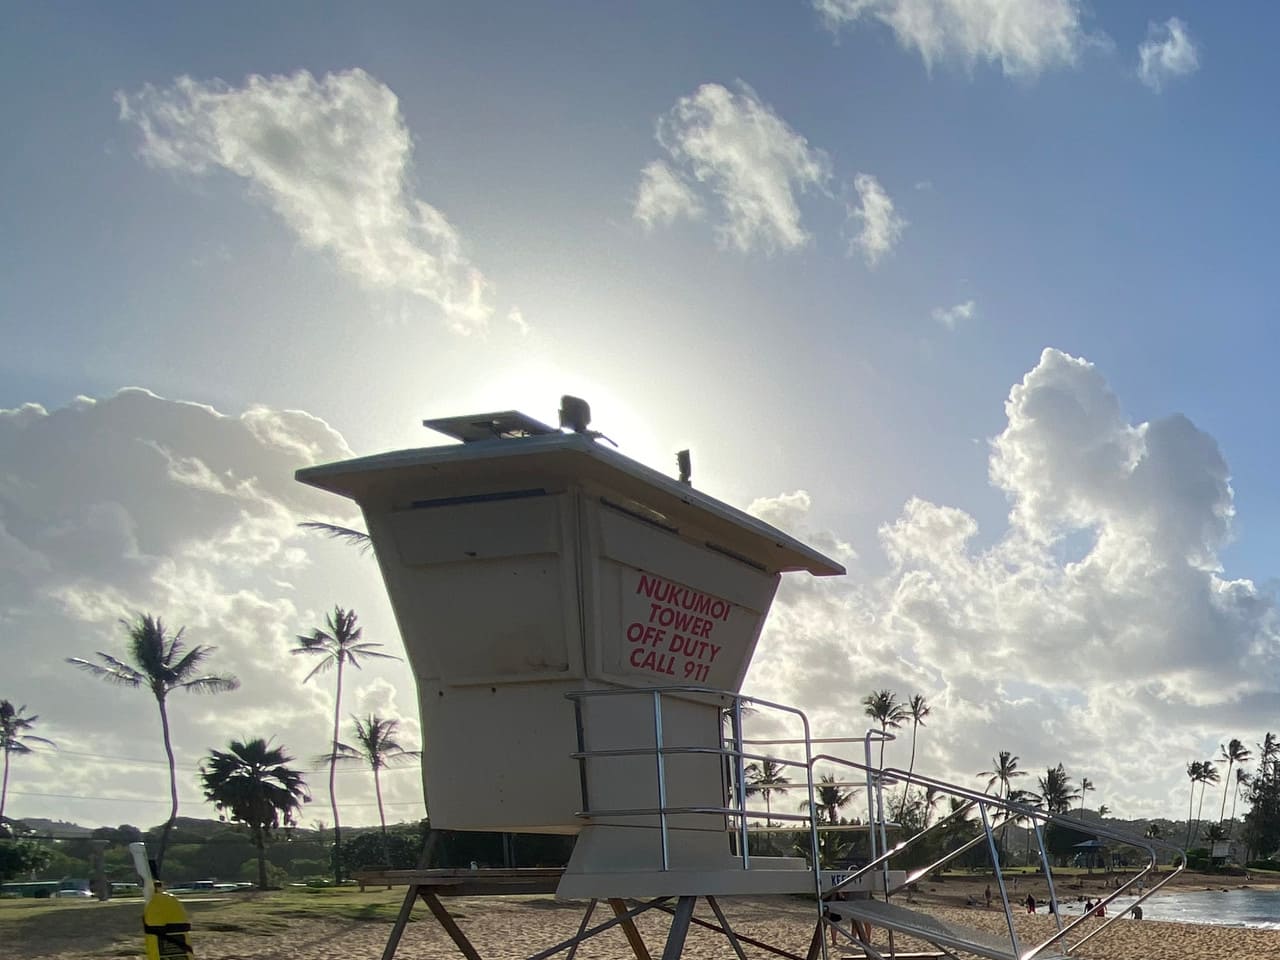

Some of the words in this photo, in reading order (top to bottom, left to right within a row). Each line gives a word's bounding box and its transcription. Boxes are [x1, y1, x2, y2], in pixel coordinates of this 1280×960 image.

[636, 575, 731, 621] NUKUMOI
[649, 603, 713, 639] TOWER
[627, 623, 666, 647] OFF
[669, 634, 721, 662] DUTY
[630, 648, 675, 675] CALL
[684, 661, 710, 682] 911
